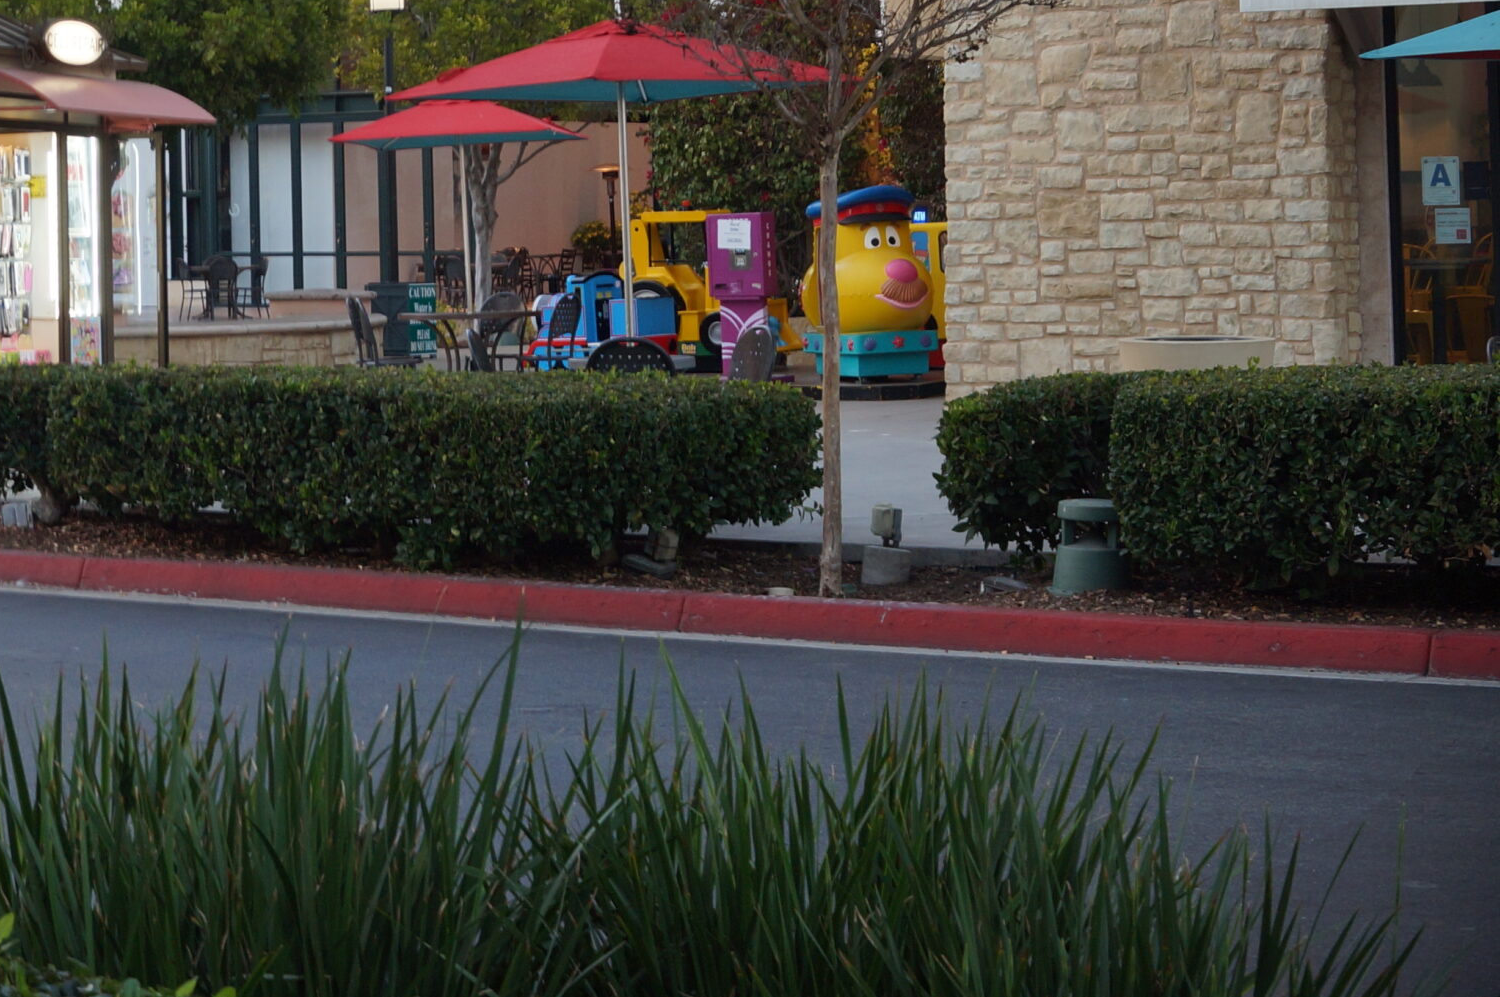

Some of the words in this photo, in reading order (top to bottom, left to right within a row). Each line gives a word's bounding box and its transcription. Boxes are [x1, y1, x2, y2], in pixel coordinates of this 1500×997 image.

[1430, 163, 1452, 187] A
[913, 211, 926, 221] ATM
[409, 287, 436, 299] CAUTION
